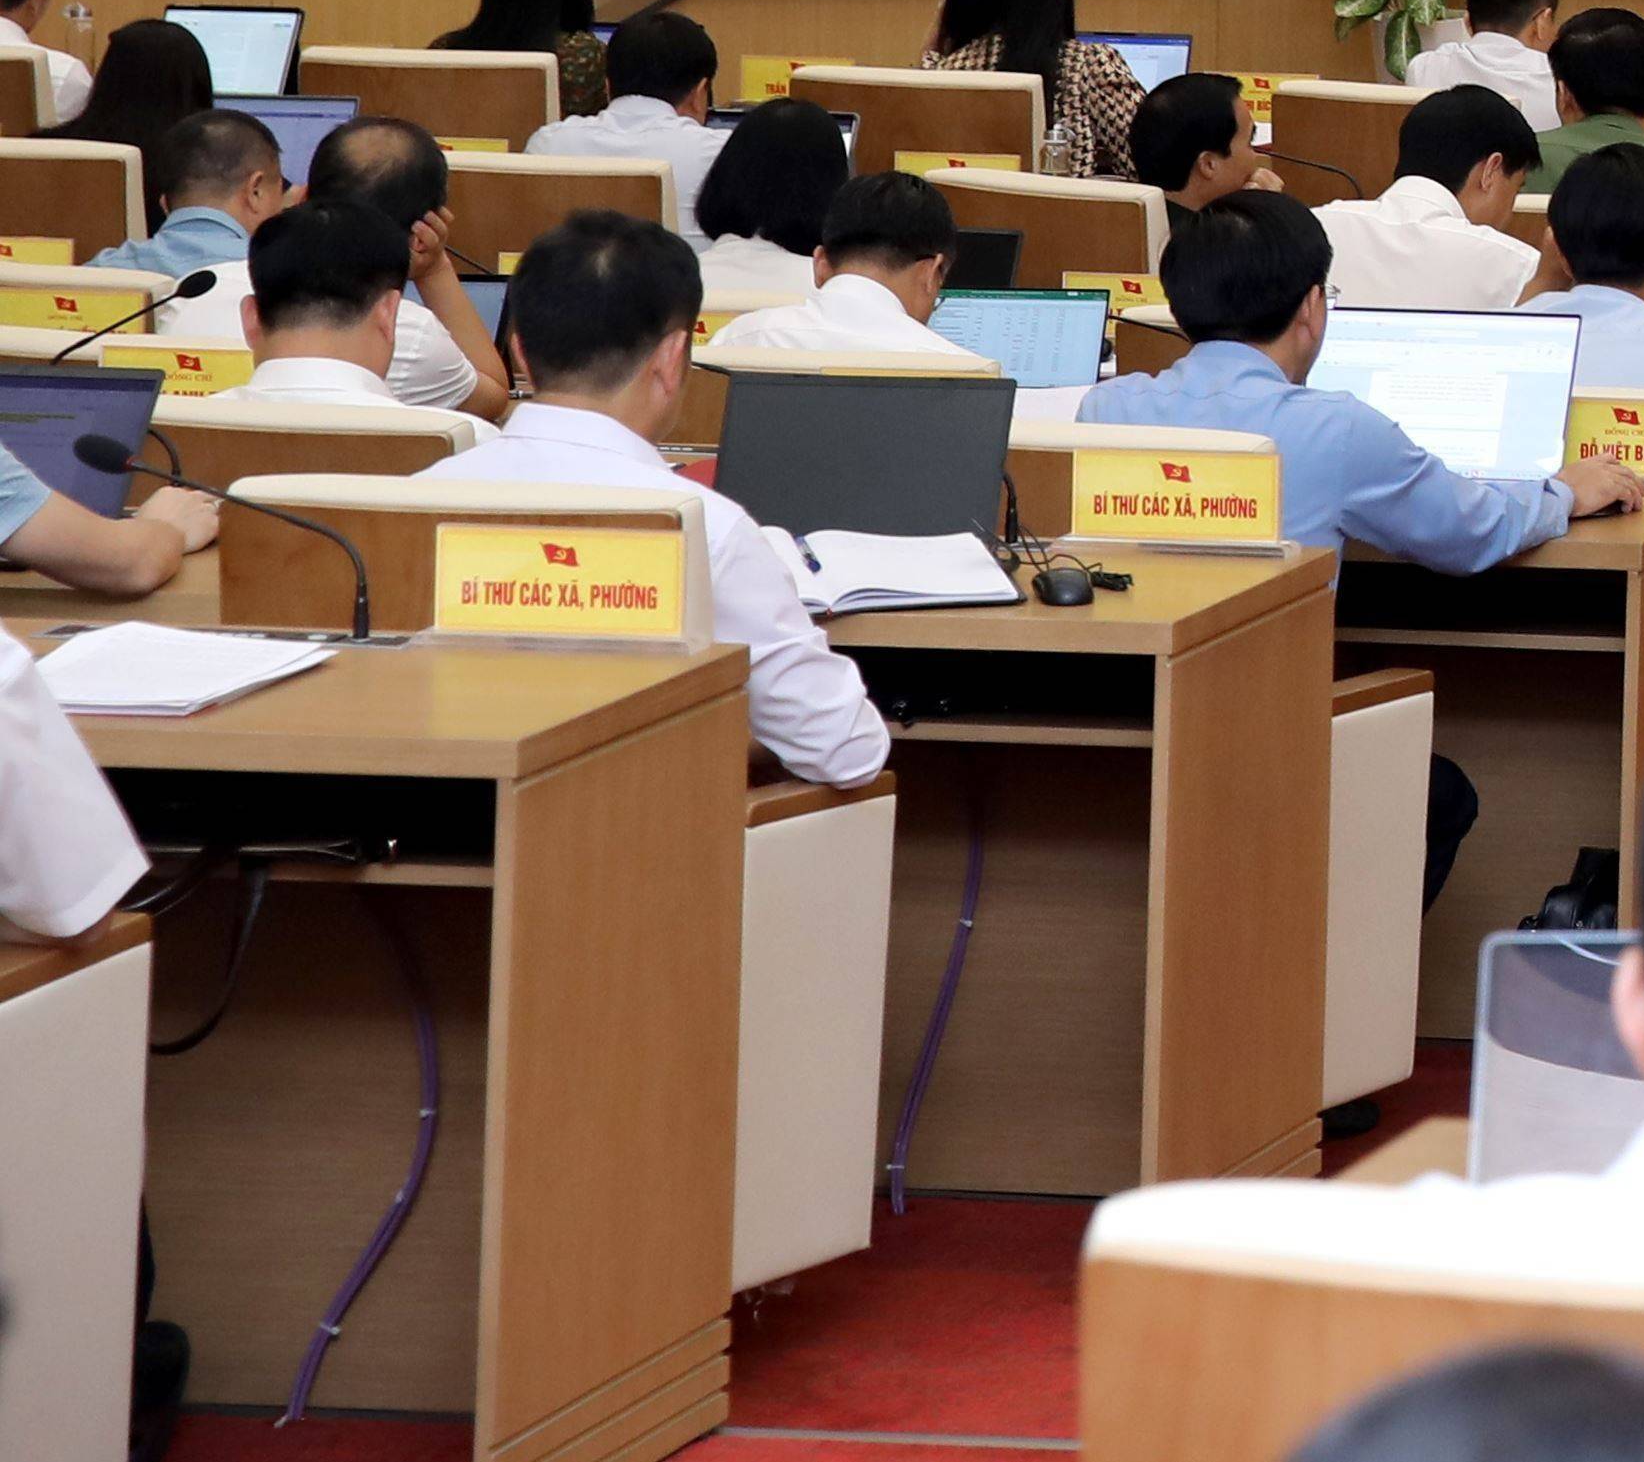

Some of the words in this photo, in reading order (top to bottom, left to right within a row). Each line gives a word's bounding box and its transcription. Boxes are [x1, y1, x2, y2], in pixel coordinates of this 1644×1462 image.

[1093, 494, 1108, 516] BÍ
[1111, 494, 1141, 518] THƯ
[1142, 493, 1171, 518] CÁC
[1201, 494, 1257, 521] PHƯỜNG
[461, 578, 480, 605] BÍ
[483, 578, 518, 608] THƯ
[519, 577, 554, 608] CÁC
[590, 579, 658, 611] PHƯỜNG
